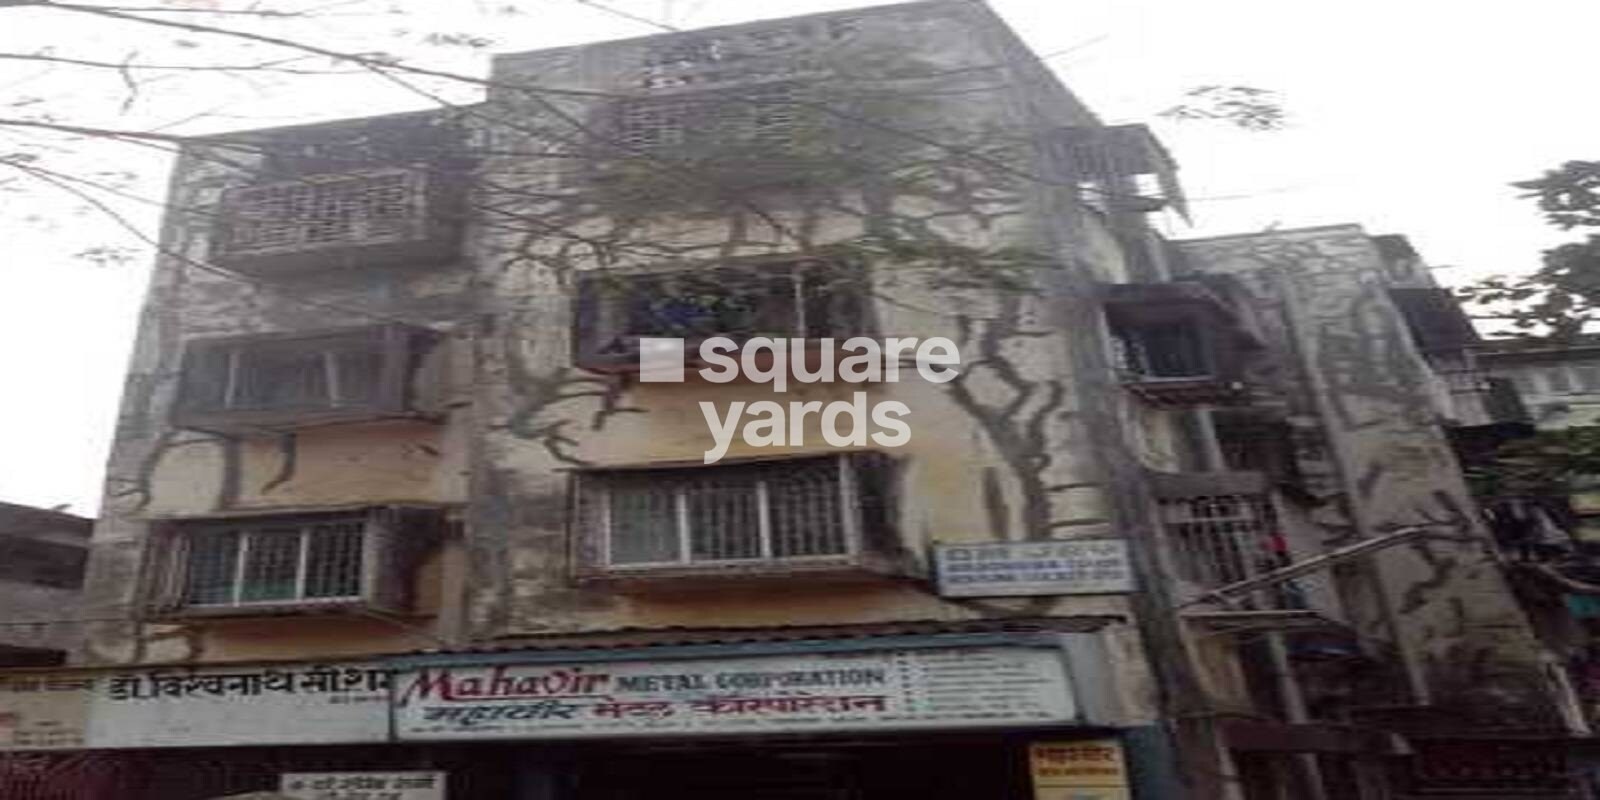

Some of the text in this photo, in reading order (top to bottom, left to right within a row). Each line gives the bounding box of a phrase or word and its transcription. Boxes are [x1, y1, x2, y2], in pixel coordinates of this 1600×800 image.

[401, 663, 613, 706] Mahavir
[614, 673, 707, 692] METAL
[716, 669, 886, 690] CORPORATION
